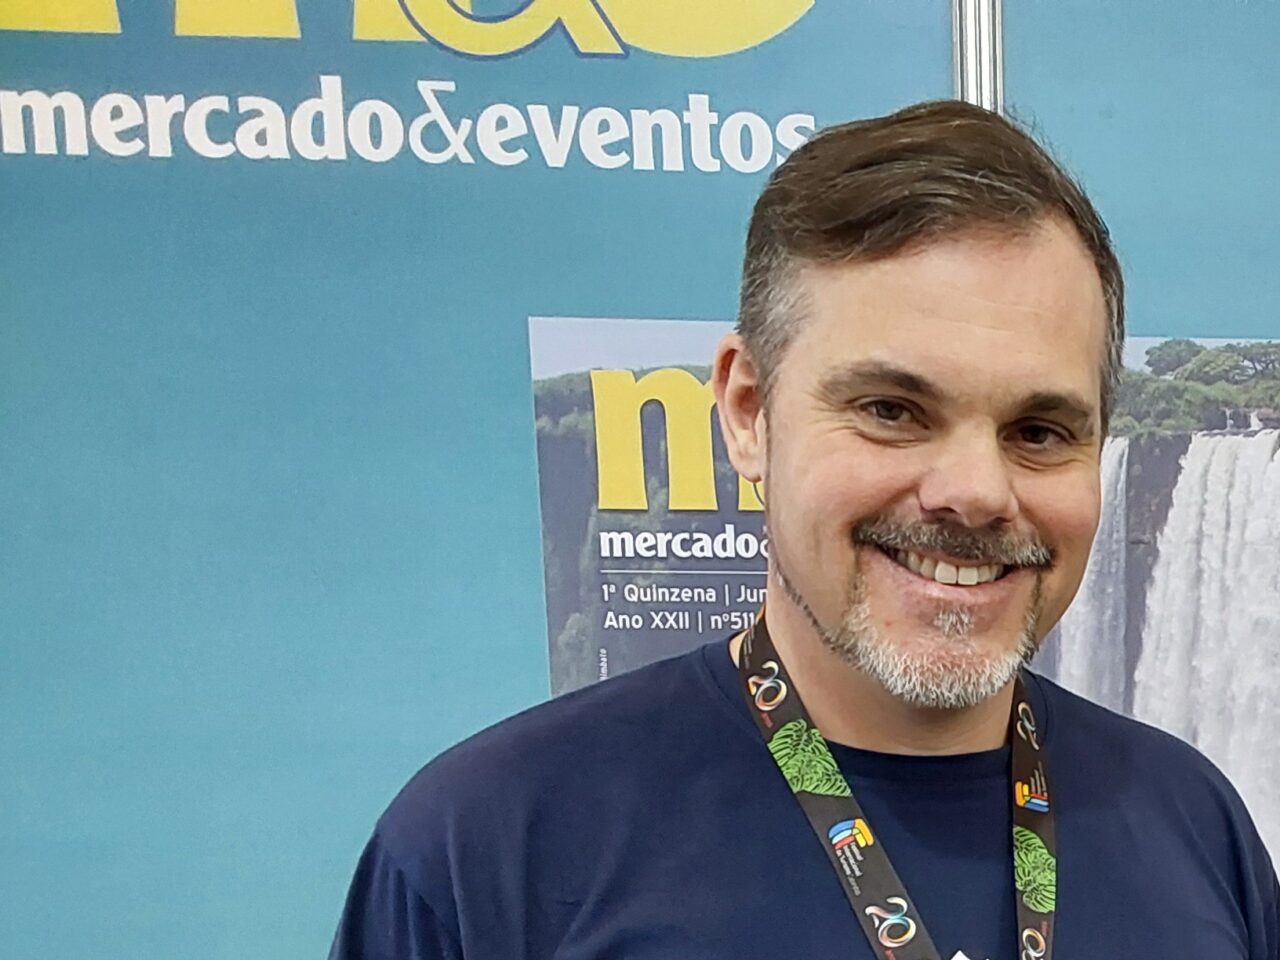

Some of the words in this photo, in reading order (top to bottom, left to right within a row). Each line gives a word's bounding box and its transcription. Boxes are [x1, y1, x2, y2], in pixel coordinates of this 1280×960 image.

[624, 584, 716, 604] Quinzena
[603, 611, 644, 630] Ano
[650, 611, 690, 630] XXII
